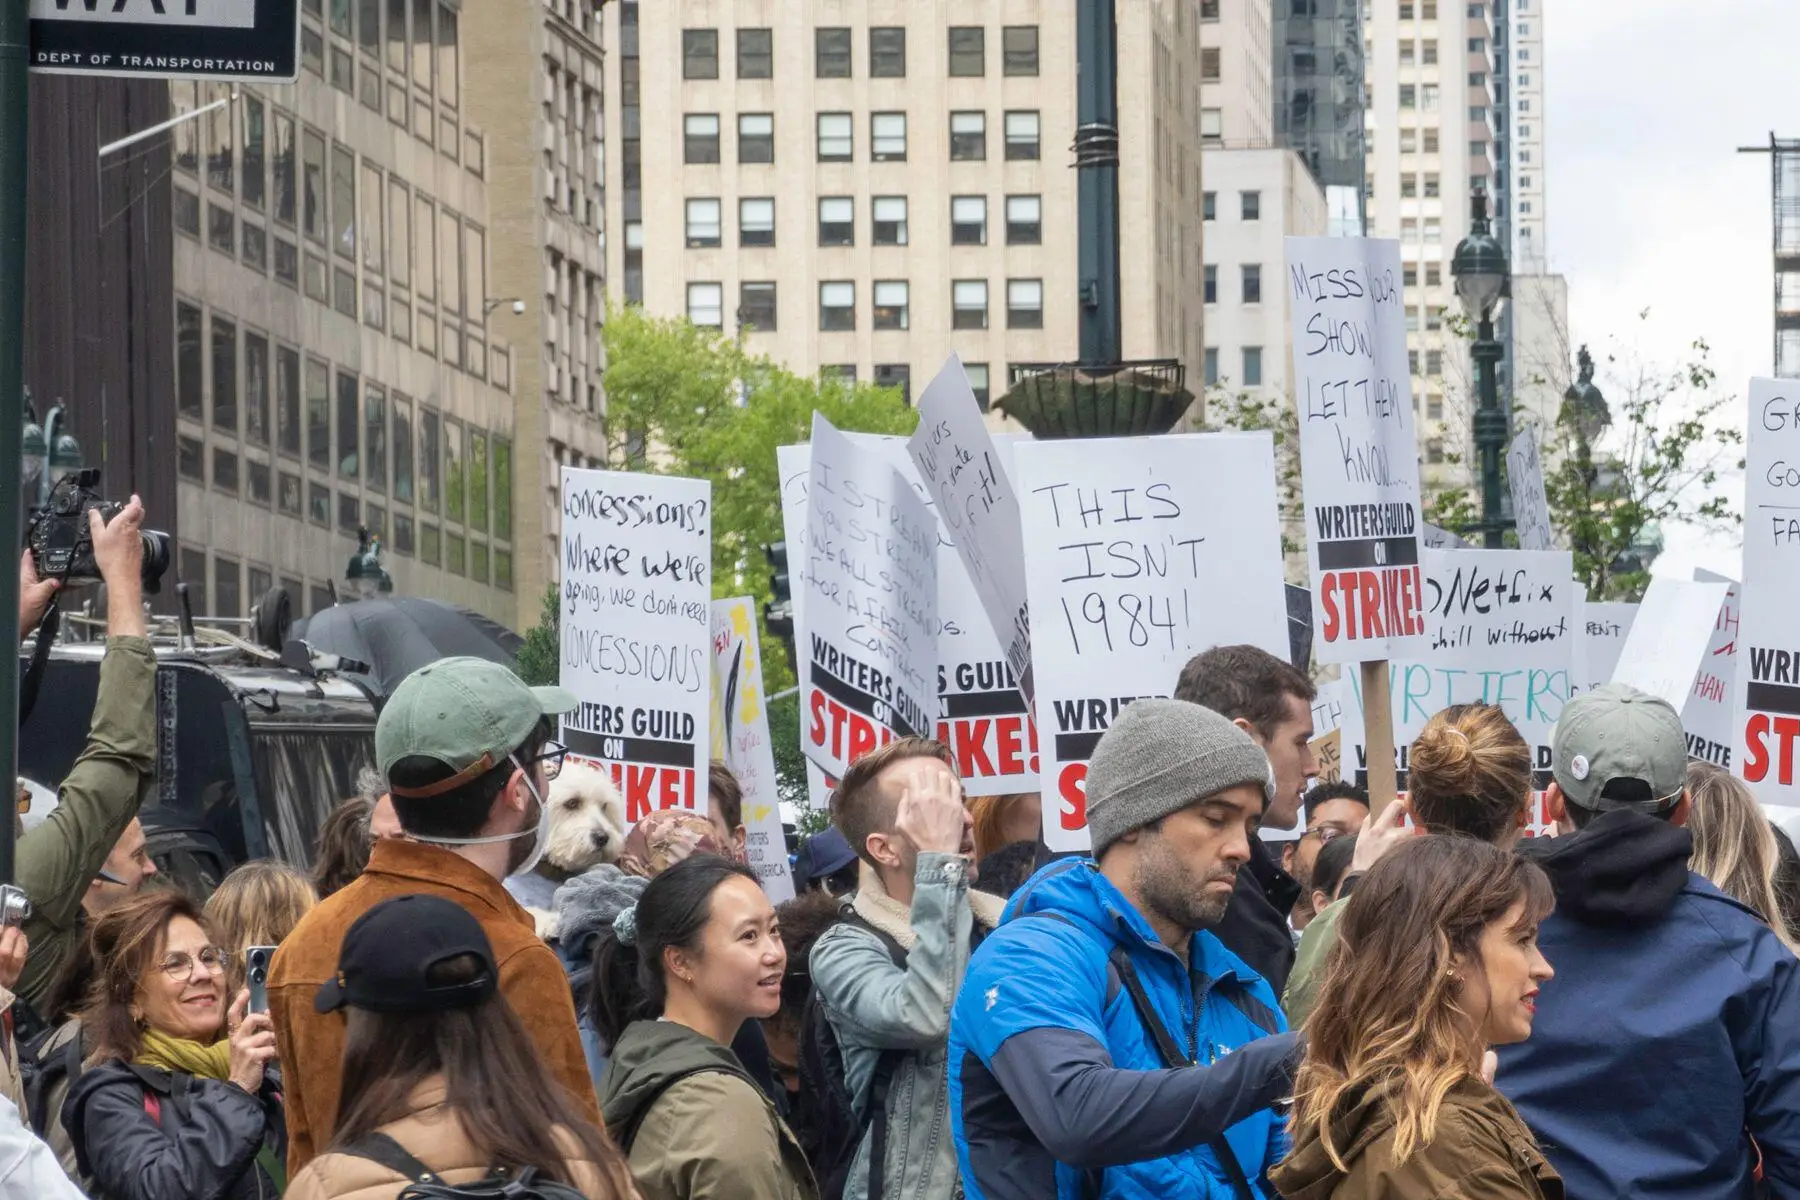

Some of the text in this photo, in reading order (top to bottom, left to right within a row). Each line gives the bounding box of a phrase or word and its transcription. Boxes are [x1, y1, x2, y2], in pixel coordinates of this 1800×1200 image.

[38, 53, 276, 72] DEPT OF TRANSPORTATION
[1291, 262, 1363, 303] MISS
[1307, 377, 1403, 429] LET THEM
[1032, 483, 1181, 528] THIS
[1315, 502, 1415, 540] WRITERS GUILD
[565, 532, 631, 576] Where
[1058, 534, 1206, 582] ISN'T
[1374, 541, 1387, 565] ON
[681, 600, 707, 626] need
[1061, 588, 1192, 656] 1984!
[1320, 566, 1424, 643] STRIKE!
[1487, 615, 1568, 646] without
[565, 622, 703, 693] CONCESSIONS
[811, 632, 892, 702] WRITERS
[896, 686, 931, 740] GUILD
[632, 707, 695, 741] GUILD
[872, 699, 893, 728] ON
[603, 738, 624, 760] ON
